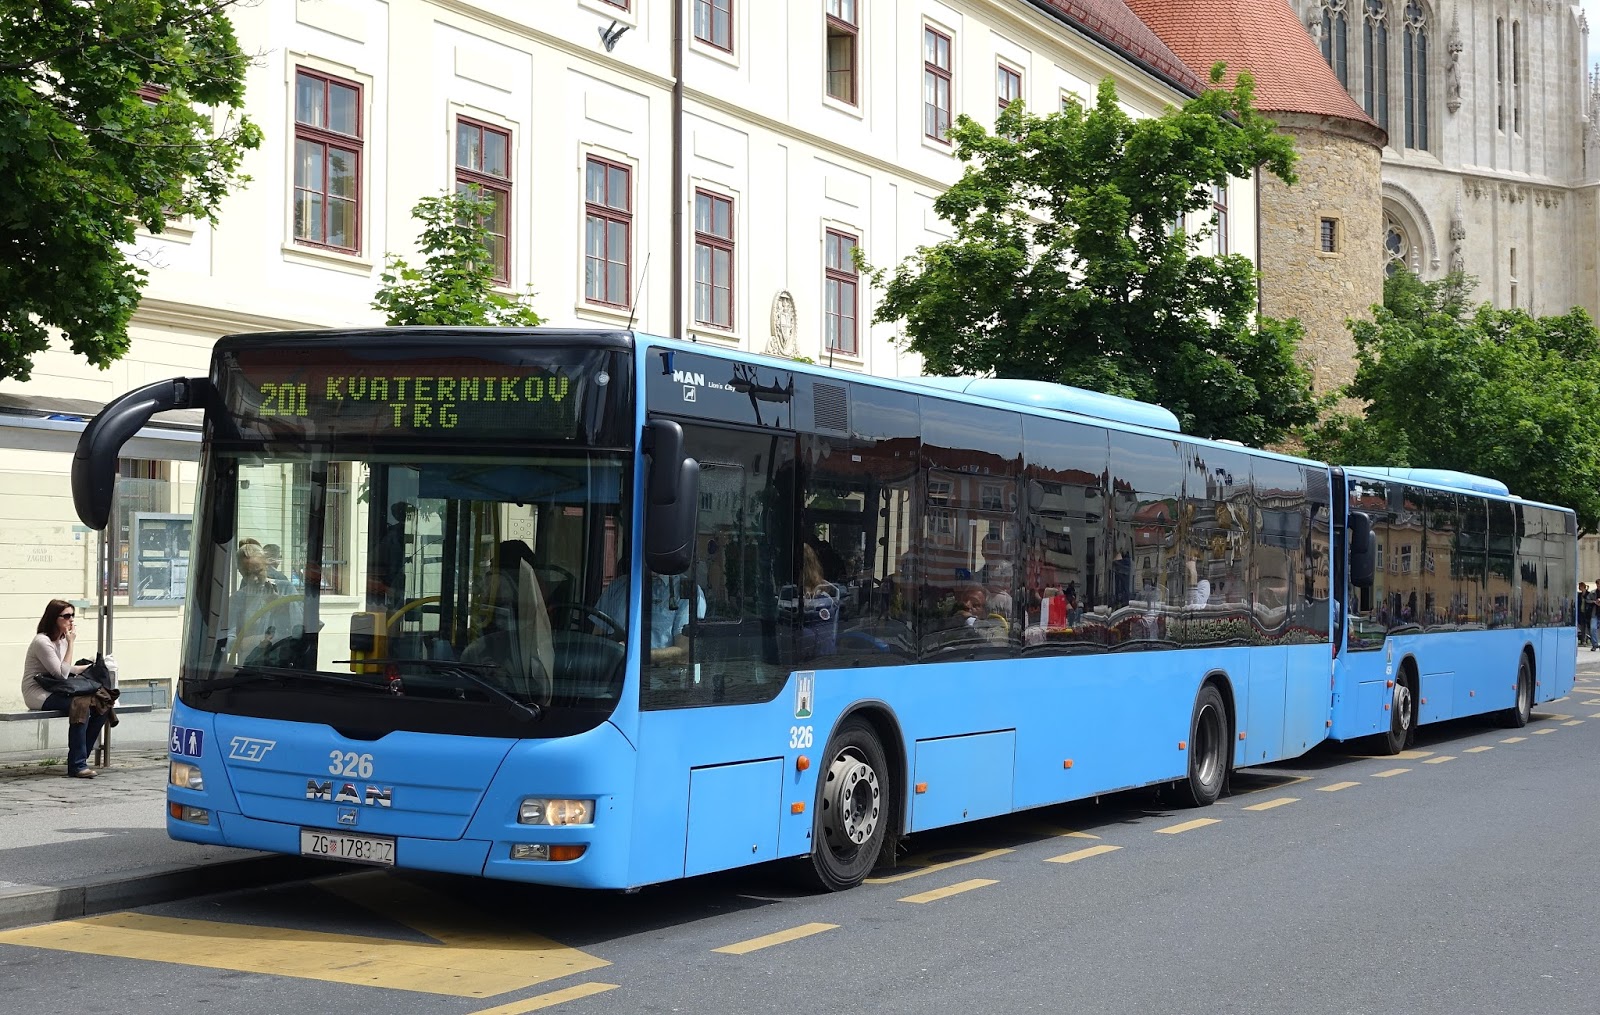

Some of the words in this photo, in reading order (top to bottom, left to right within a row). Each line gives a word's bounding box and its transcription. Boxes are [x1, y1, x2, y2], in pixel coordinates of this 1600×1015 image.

[673, 369, 705, 386] MAN
[708, 381, 723, 390] Lion's
[724, 383, 736, 392] City
[259, 383, 308, 416] 201
[326, 376, 570, 402] KVATERNIKOV
[389, 403, 458, 428] TRG
[789, 725, 814, 749] 326
[328, 750, 374, 778] 326
[306, 778, 393, 807] MAN
[312, 834, 329, 854] ZG
